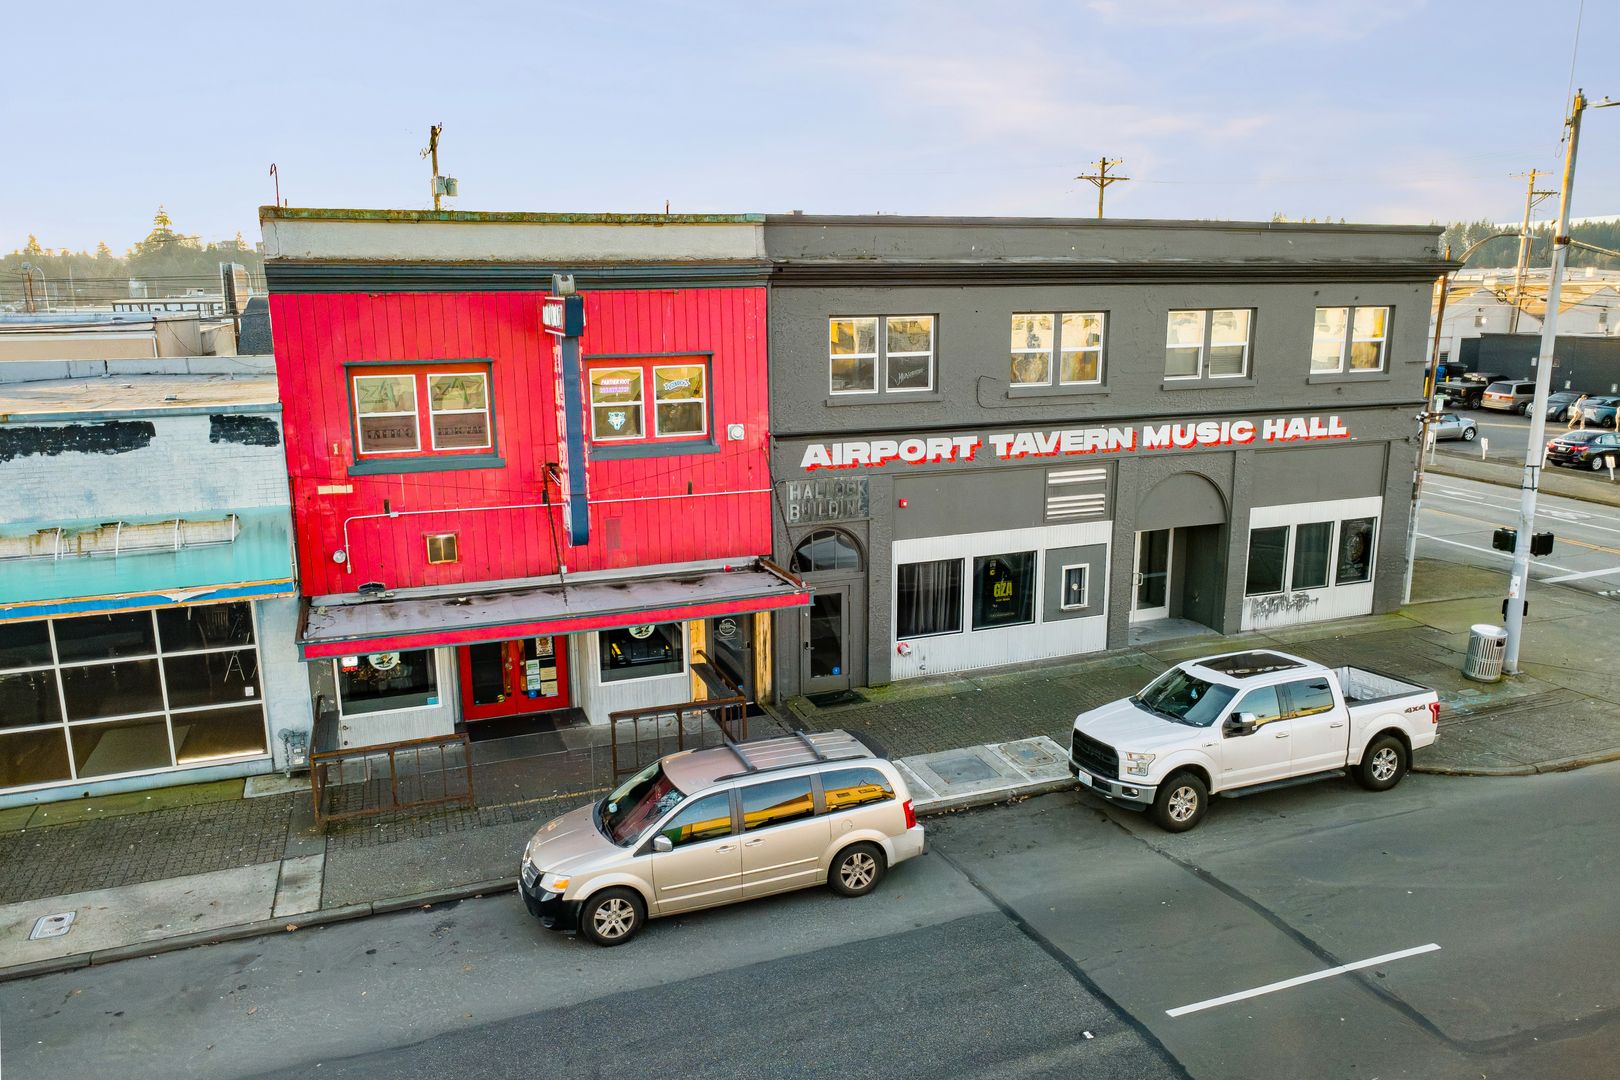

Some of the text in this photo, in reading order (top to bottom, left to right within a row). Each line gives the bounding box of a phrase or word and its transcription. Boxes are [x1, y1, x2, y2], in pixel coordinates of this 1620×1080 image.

[800, 416, 1348, 469] AIRPORT TAVERN MUSIC HALL
[994, 581, 1013, 597] GZA
